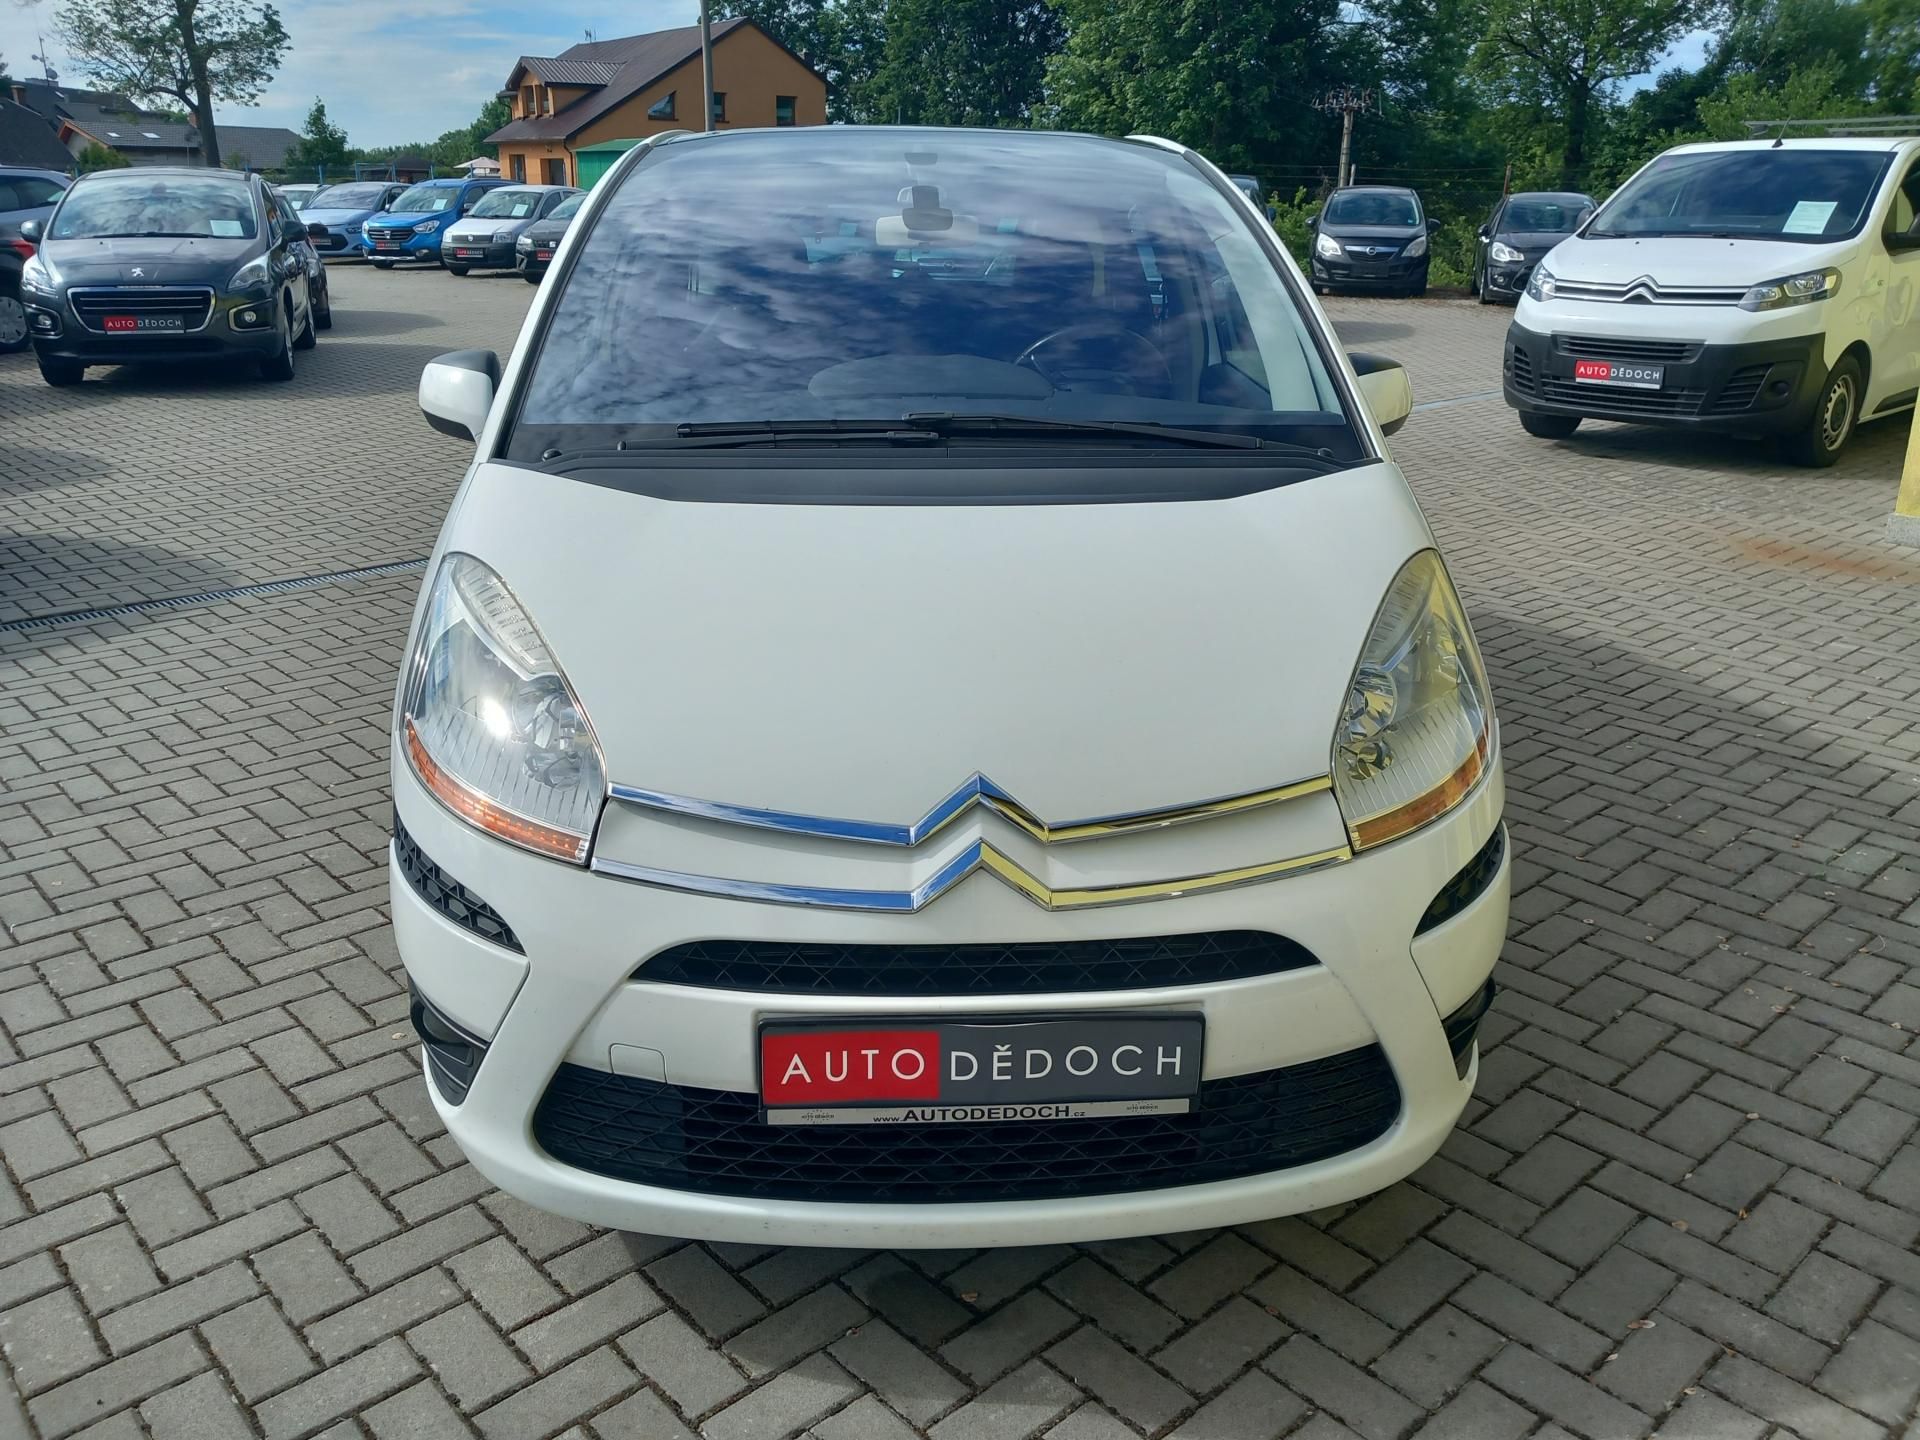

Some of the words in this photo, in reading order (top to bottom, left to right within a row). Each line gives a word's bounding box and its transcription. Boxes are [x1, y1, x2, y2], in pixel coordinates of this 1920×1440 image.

[107, 320, 135, 328] AUTO
[1578, 365, 1608, 376] AUTO
[780, 1048, 925, 1085] AUTO
[950, 1043, 1181, 1081] DĚDOCH
[873, 1105, 1086, 1122] www.AUTODEDOCH.cz
